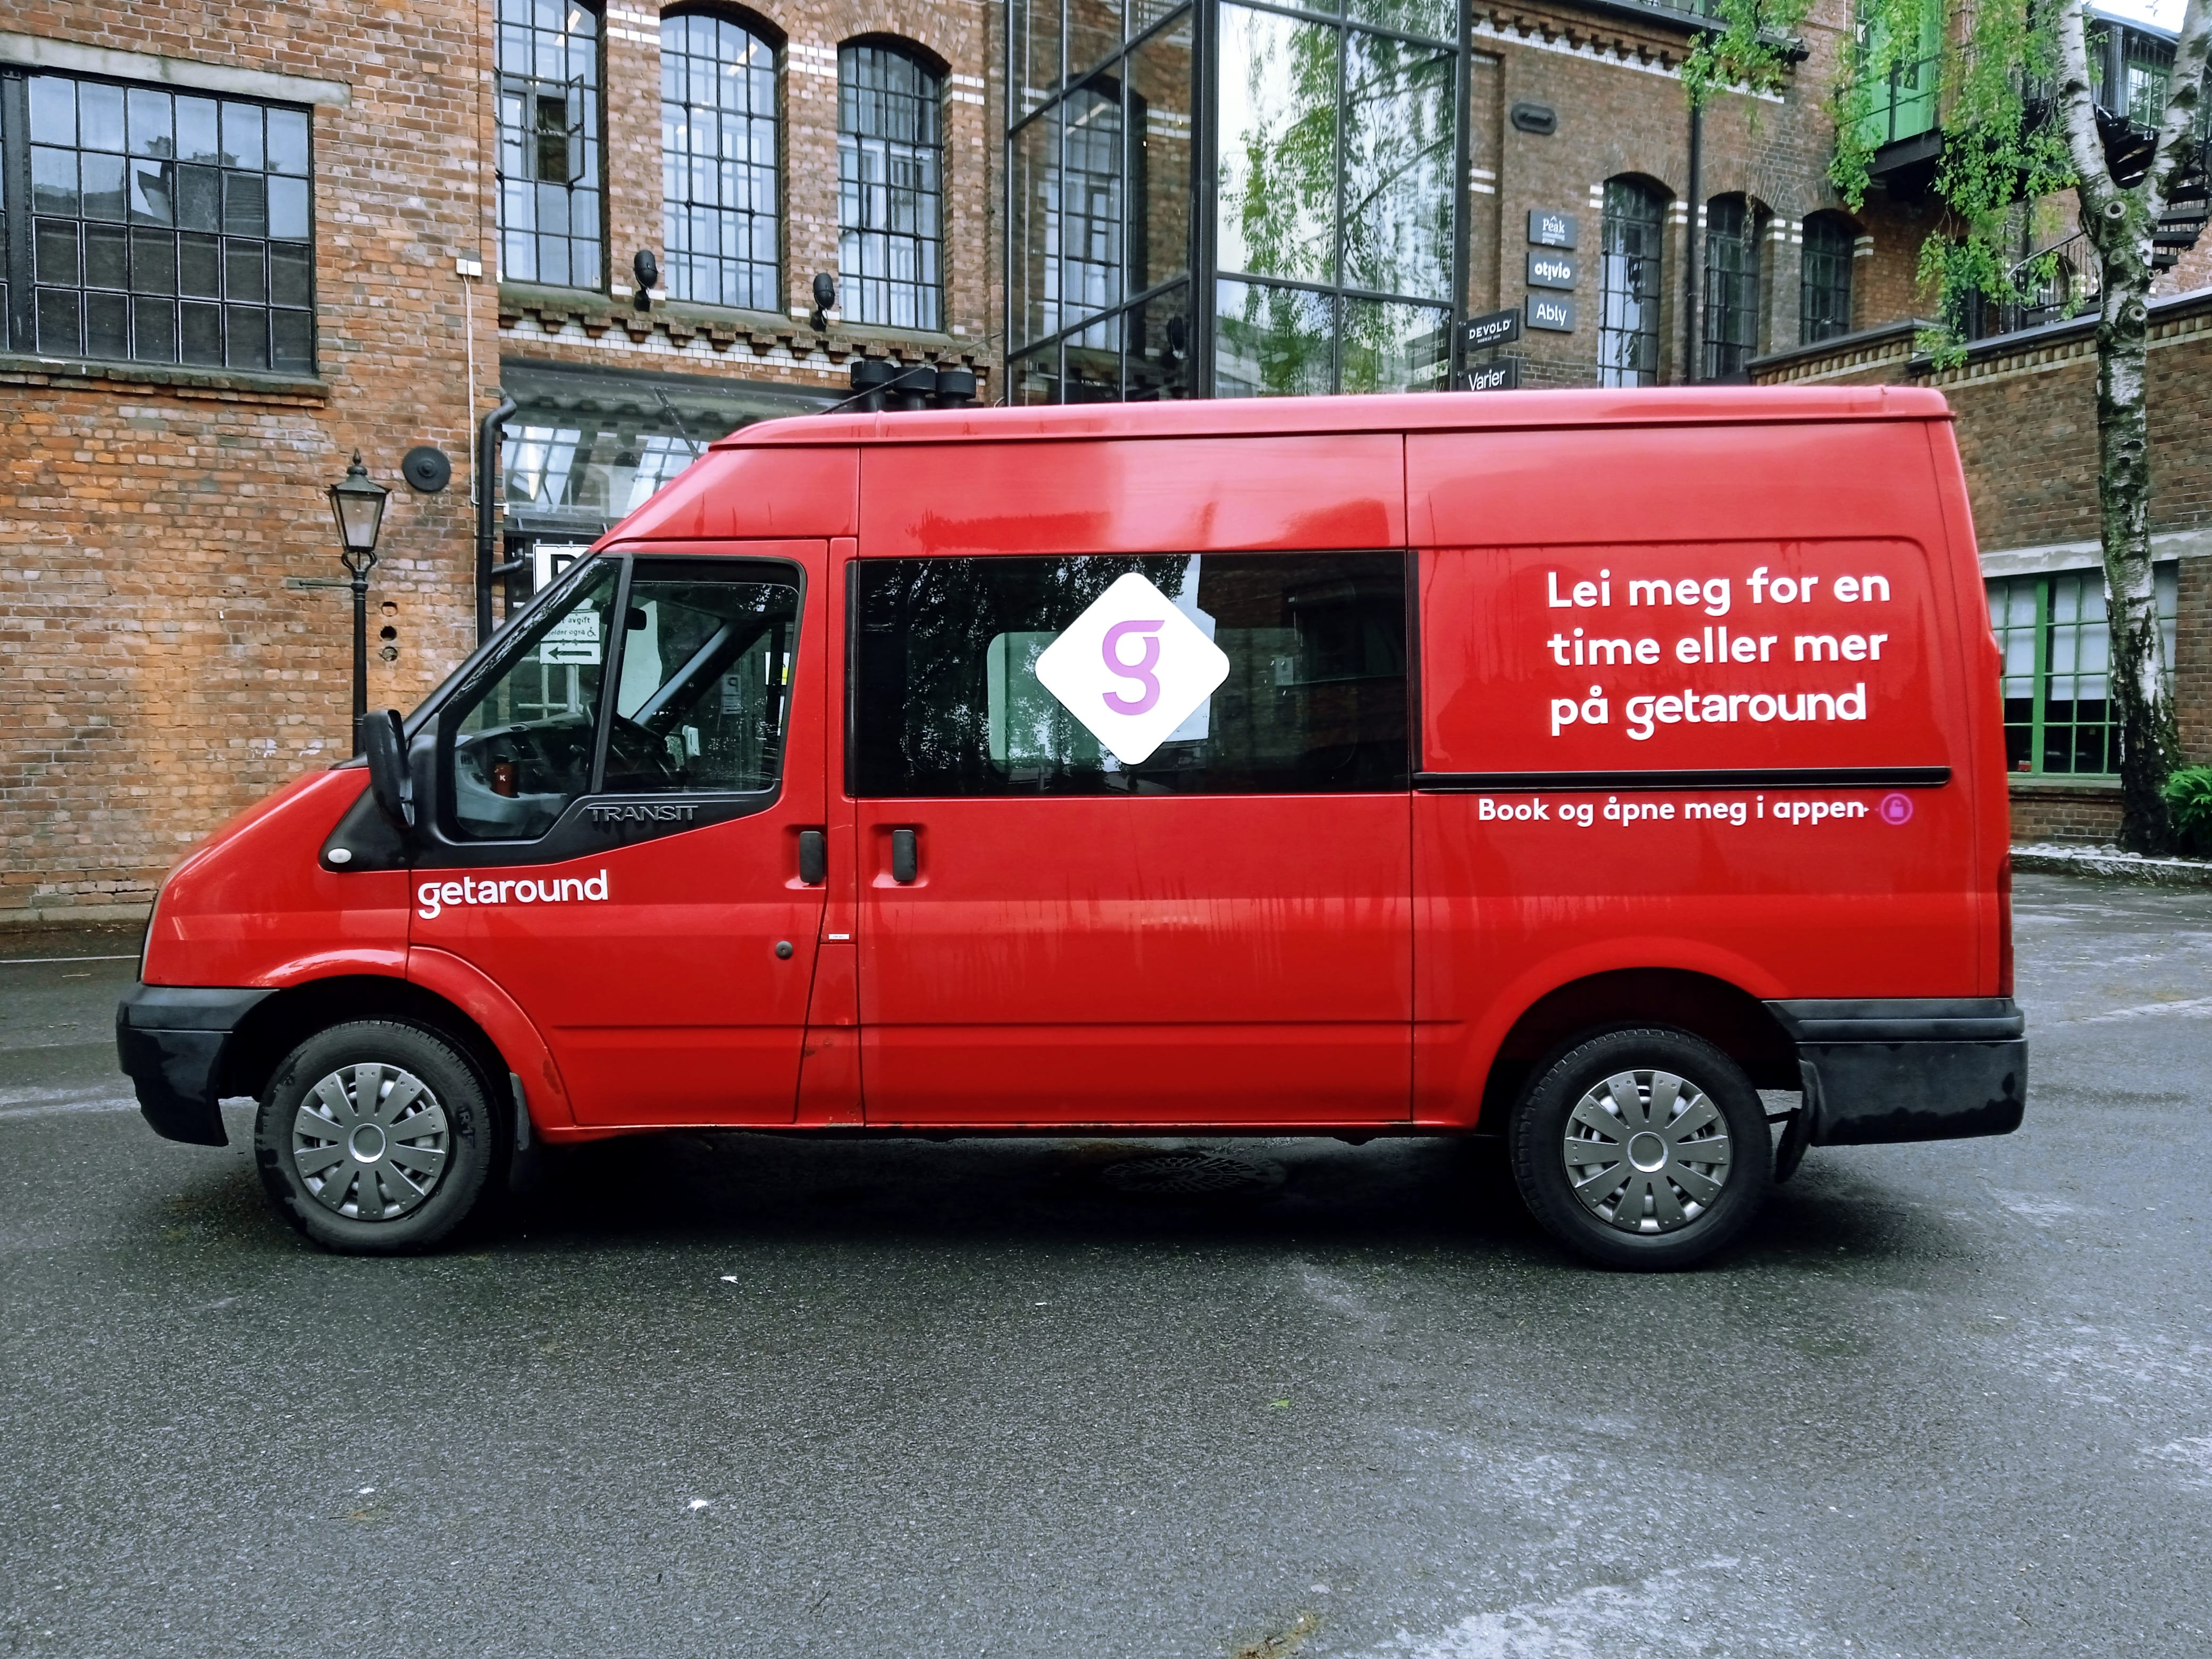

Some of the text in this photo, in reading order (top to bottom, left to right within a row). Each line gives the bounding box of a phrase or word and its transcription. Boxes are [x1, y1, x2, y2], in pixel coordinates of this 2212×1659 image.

[1543, 219, 1565, 234] Peak
[1536, 303, 1567, 326] Ably
[1469, 320, 1510, 340] DEVOLD
[1468, 368, 1506, 391] Varier
[1548, 567, 1890, 616] Lei meg for en
[1547, 626, 1888, 666] time eller mer
[1551, 683, 1866, 740] på getaround
[587, 806, 698, 822] TRANSIT
[1479, 795, 1865, 827] Book og åpne meg i appen
[418, 869, 608, 919] getaround
